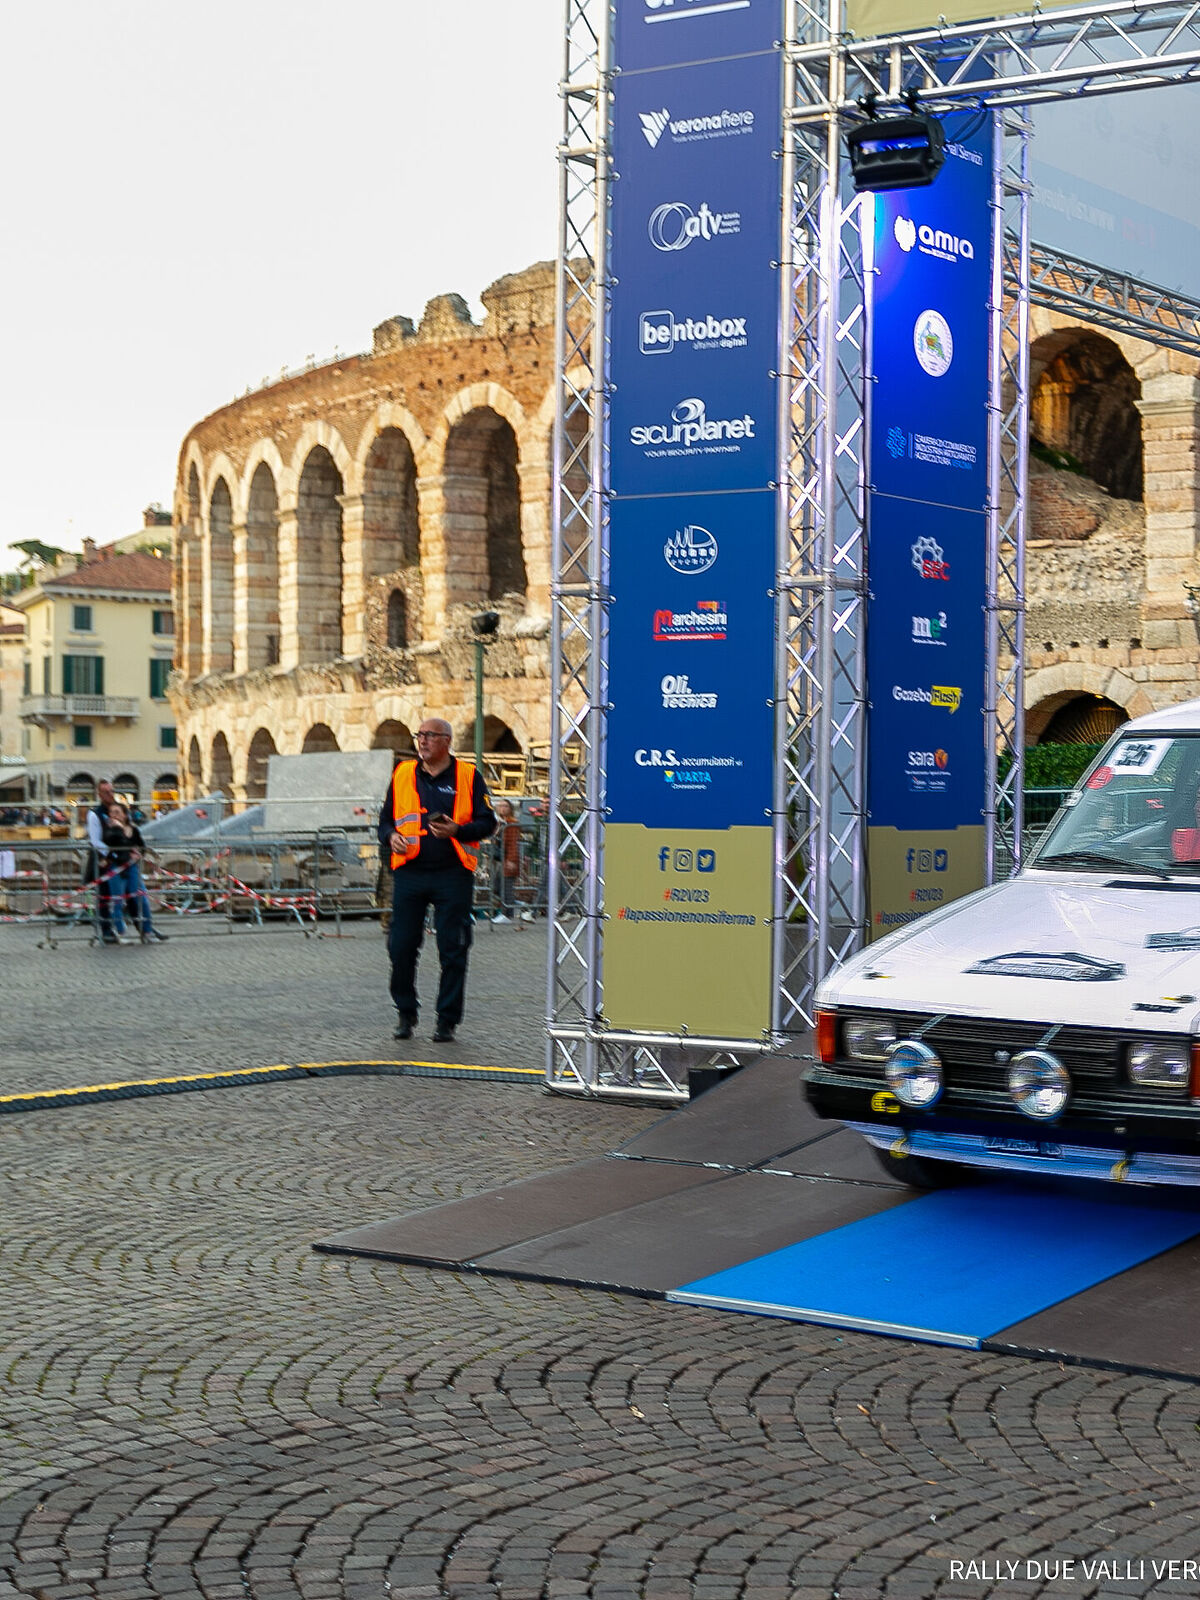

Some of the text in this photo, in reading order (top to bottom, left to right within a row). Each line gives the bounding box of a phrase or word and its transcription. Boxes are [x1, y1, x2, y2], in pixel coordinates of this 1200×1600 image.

[918, 225, 974, 260] amia
[643, 315, 747, 344] bentobox
[630, 414, 755, 446] sicurplanet
[908, 751, 935, 766] sara
